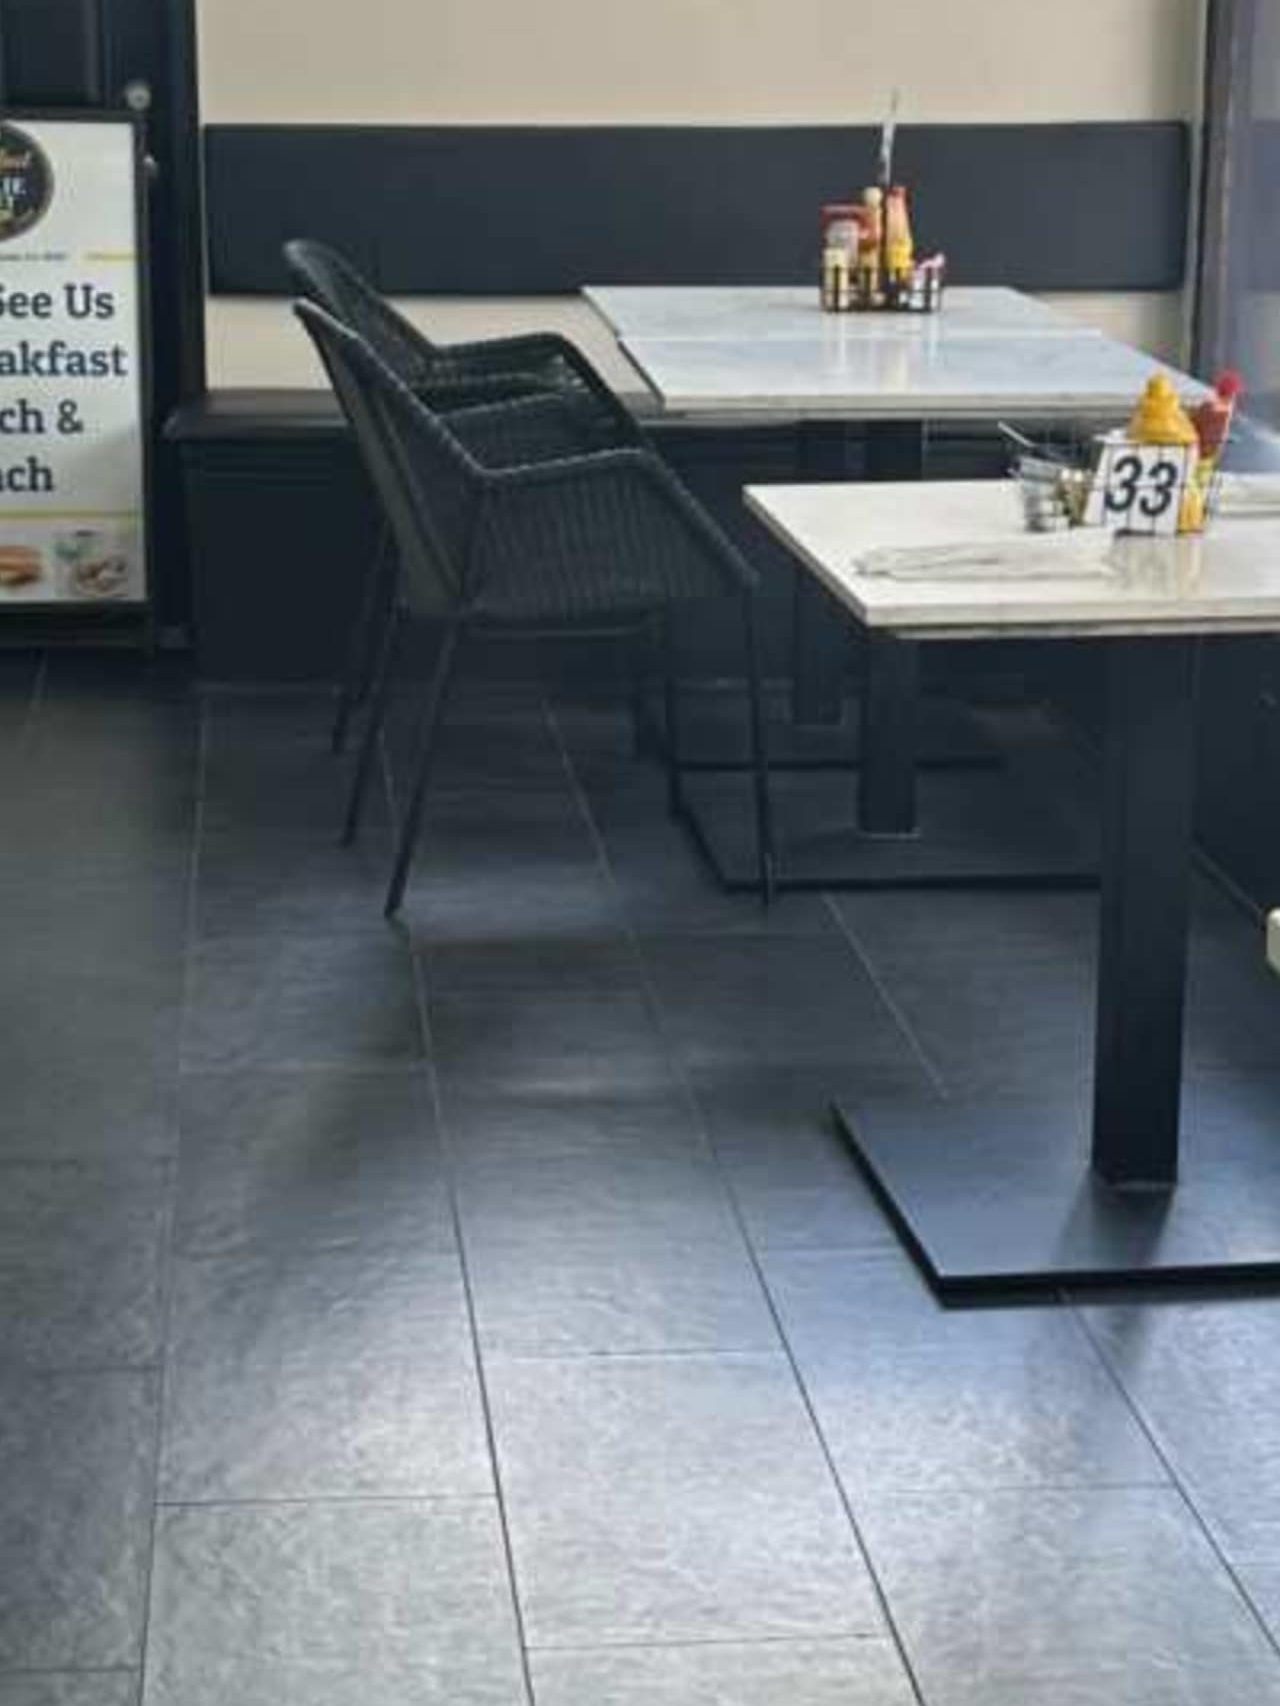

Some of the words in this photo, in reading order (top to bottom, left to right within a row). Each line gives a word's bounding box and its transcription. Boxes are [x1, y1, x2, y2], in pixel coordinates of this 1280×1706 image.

[64, 283, 115, 320] Us
[57, 398, 84, 436] &
[1104, 455, 1178, 517] 33
